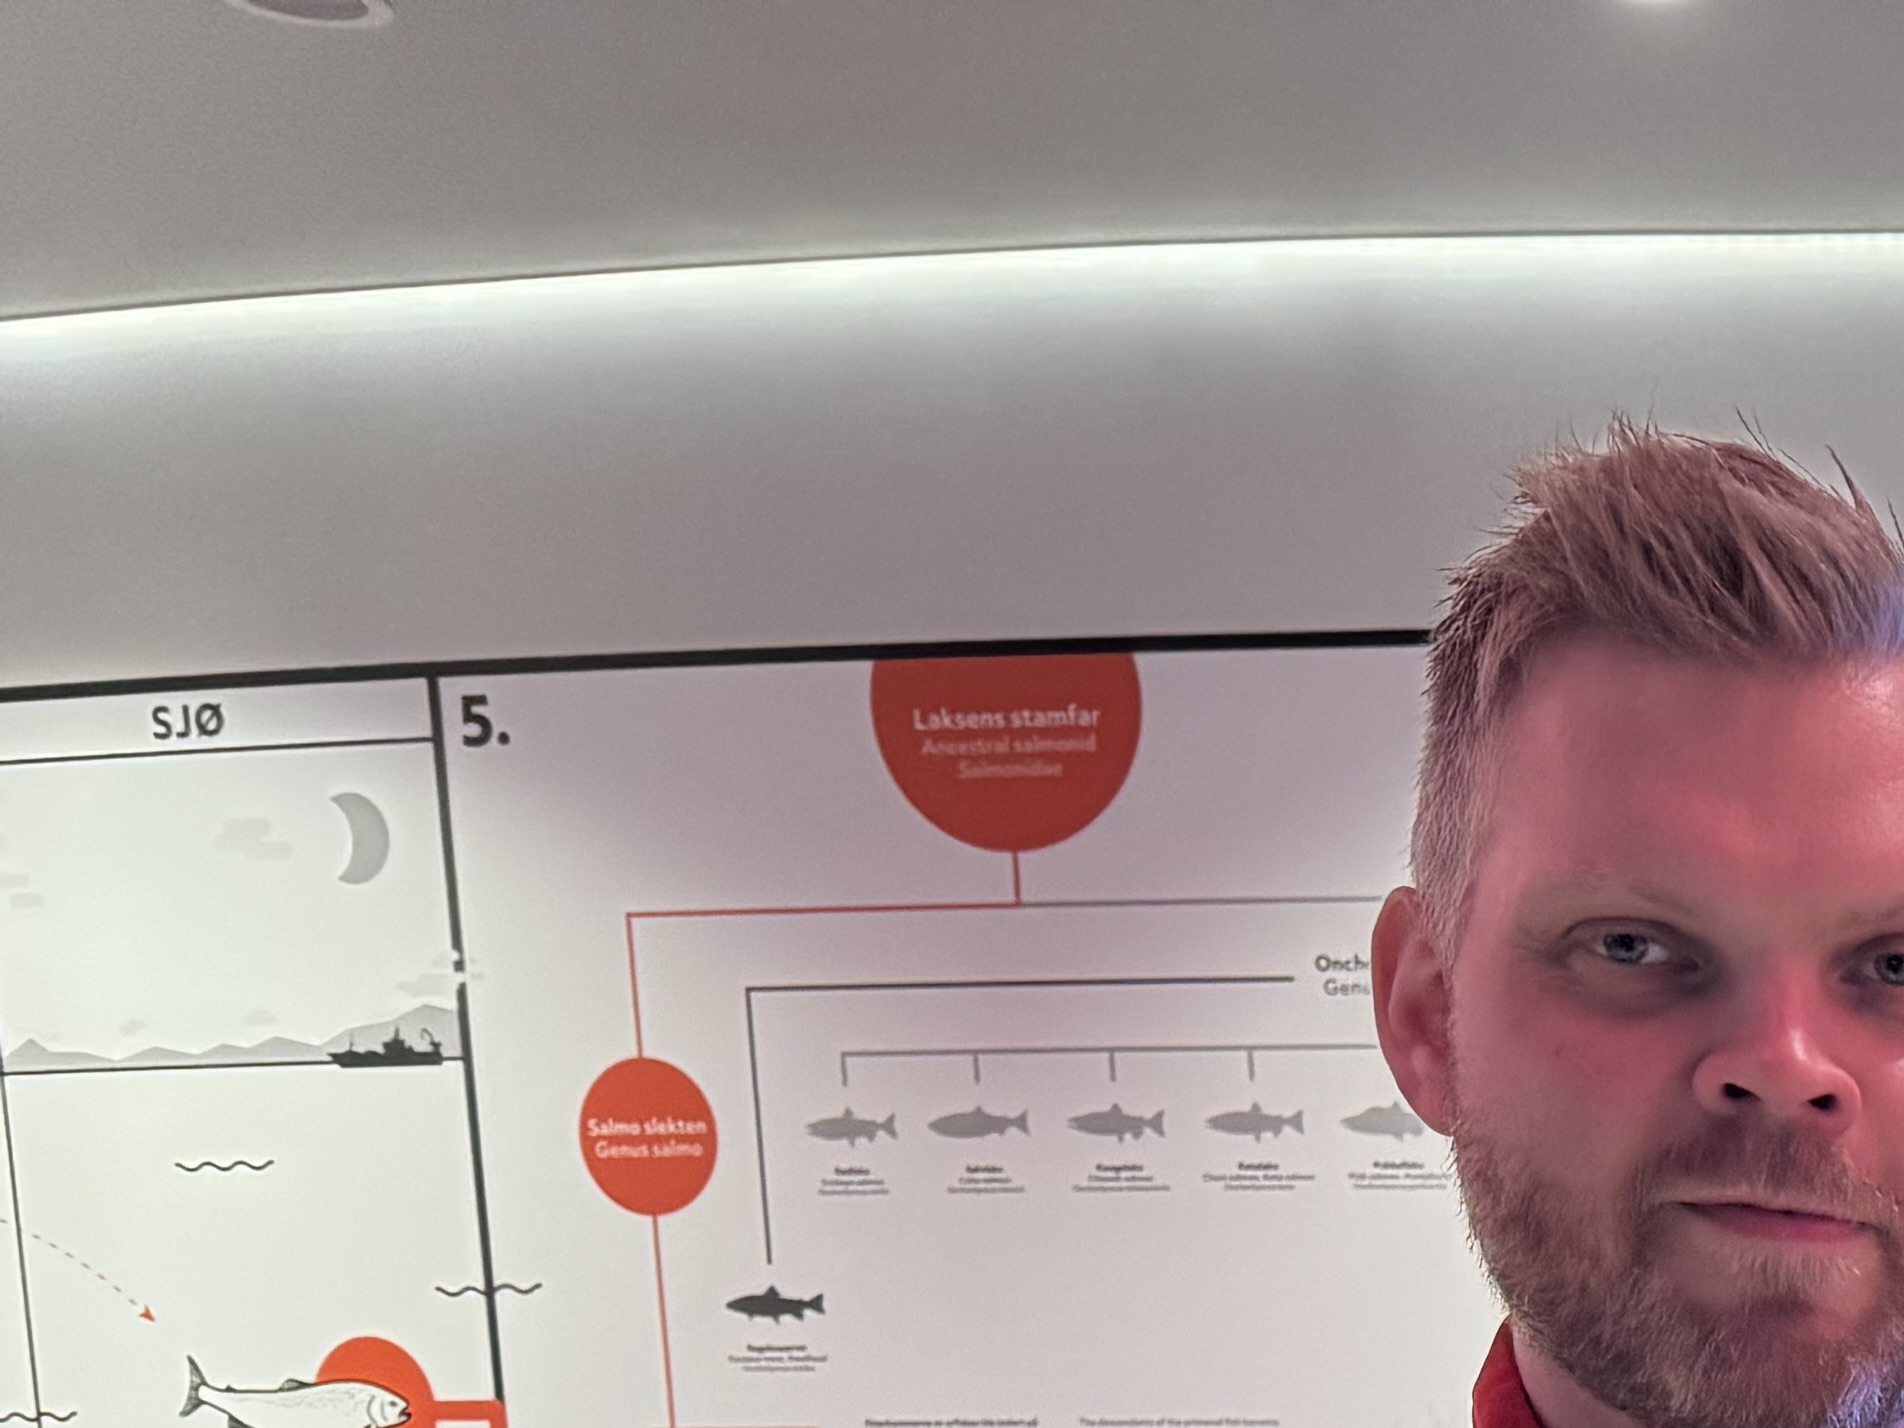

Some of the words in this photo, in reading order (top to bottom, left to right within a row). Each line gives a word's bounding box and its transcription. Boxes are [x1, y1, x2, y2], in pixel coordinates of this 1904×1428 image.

[152, 702, 225, 740] SJØ
[460, 693, 512, 748] 5.
[912, 708, 1005, 731] Laksens
[1010, 703, 1100, 728] stamfar
